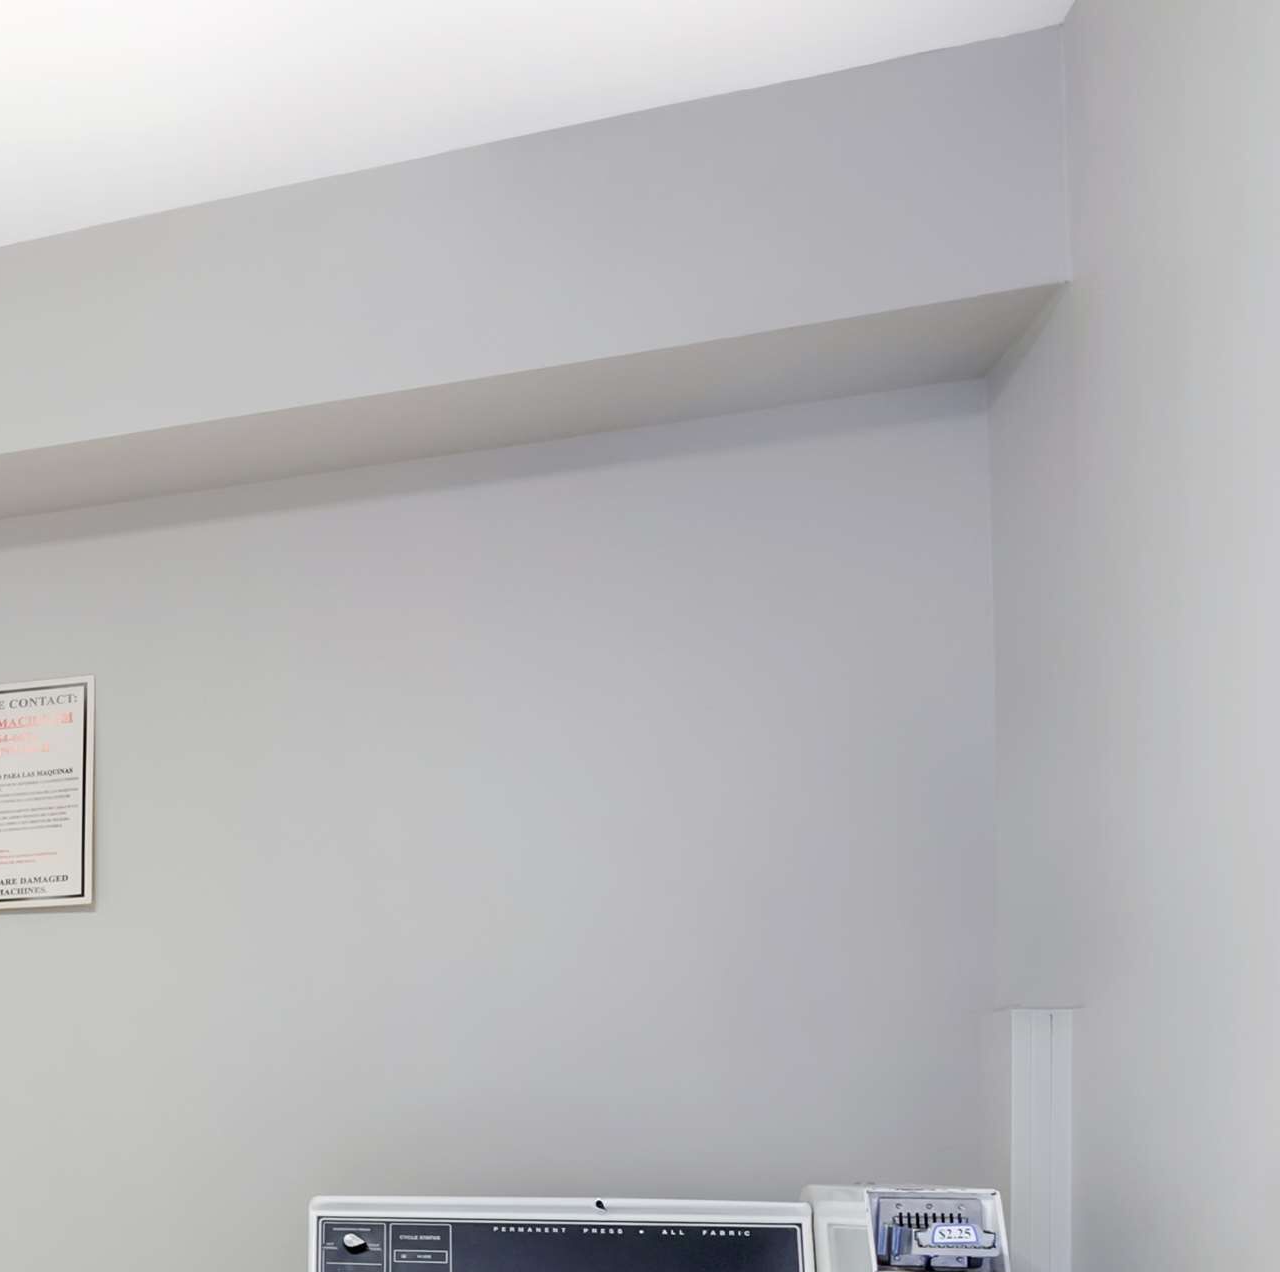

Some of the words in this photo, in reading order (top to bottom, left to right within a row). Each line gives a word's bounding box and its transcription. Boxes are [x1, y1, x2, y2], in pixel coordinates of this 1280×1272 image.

[9, 694, 78, 709] CONTACT:
[0, 878, 18, 886] ARE
[20, 874, 69, 885] DAMAGED
[583, 1227, 624, 1235] PRESS
[938, 1228, 972, 1240] $2.25
